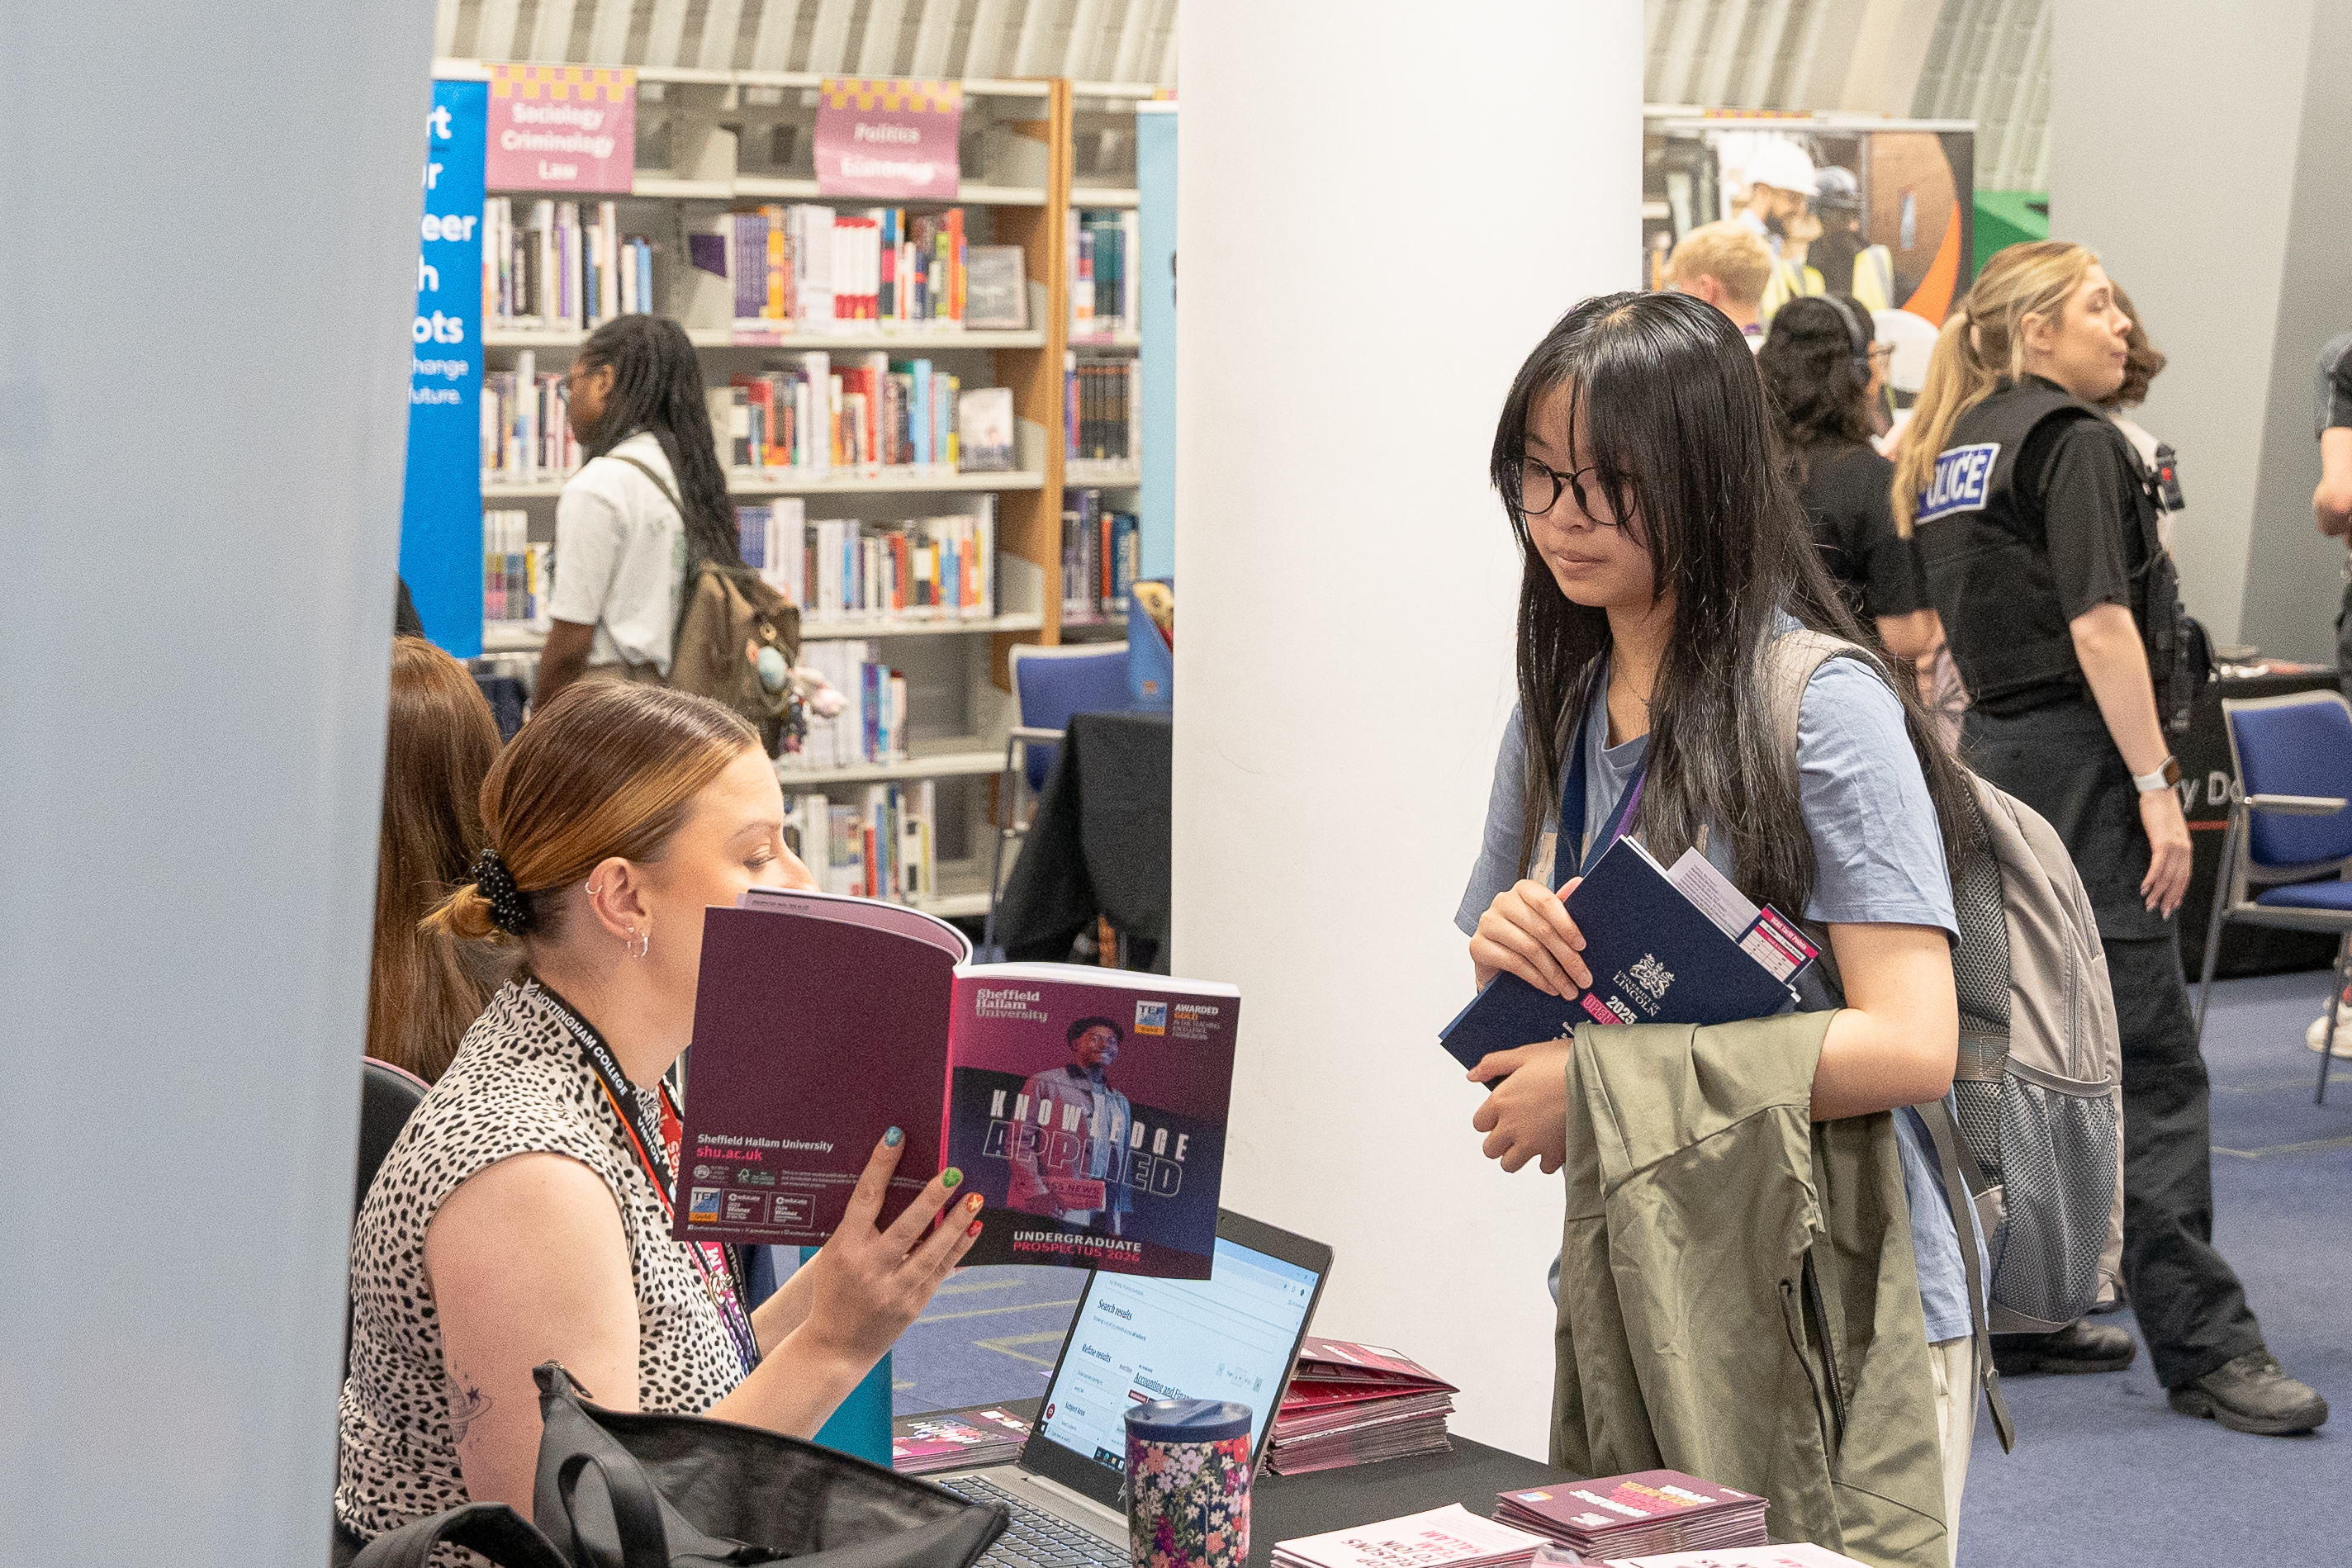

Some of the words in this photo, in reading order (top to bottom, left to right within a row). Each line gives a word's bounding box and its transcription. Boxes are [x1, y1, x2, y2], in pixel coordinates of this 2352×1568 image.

[511, 102, 605, 131] Sociology
[500, 129, 616, 159] Criminology
[854, 123, 922, 144] Politics
[538, 158, 578, 181] Law
[421, 213, 477, 242] eer
[412, 310, 464, 343] ots
[1781, 926, 1795, 939] Tariff
[1791, 935, 1807, 950] Points
[976, 988, 1041, 1002] Sheffield
[1612, 973, 1658, 1017] LINCOLN
[1618, 969, 1652, 1005] UNIVERSITY
[1651, 1001, 1662, 1011] OF
[975, 998, 1027, 1010] Hallam
[975, 1007, 1048, 1023] University
[1174, 1003, 1219, 1016] AWARDED
[1582, 995, 1613, 1025] OPEN
[1605, 995, 1638, 1025] 2025
[536, 990, 597, 1049] NOTTINGHAM
[593, 1046, 628, 1097] COLLEGE
[991, 1089, 1189, 1162] KNOWLEDGE
[637, 1116, 661, 1165] VISITOR
[697, 1134, 743, 1146] Sheffield
[745, 1137, 780, 1149] Hallam
[782, 1139, 834, 1153] University
[696, 1146, 763, 1161] shu.ac.uk
[983, 1119, 1183, 1197] APPLIED
[1013, 1241, 1102, 1258] PROSPECTUS
[1107, 1249, 1140, 1262] 2026
[1014, 1230, 1142, 1253] UNDERGRADUATE
[1098, 1299, 1117, 1314] Search
[1114, 1305, 1133, 1320] results
[1081, 1343, 1097, 1357] Refine
[1095, 1351, 1112, 1363] results
[1133, 1372, 1164, 1394] Accounting
[1163, 1386, 1176, 1398] and
[1340, 1538, 1420, 1567] REASONS
[1376, 1540, 1425, 1555] JOIN
[1414, 1541, 1463, 1559] TEAM
[1419, 1530, 1488, 1555] HALLAM
[1411, 1553, 1440, 1563] TO
